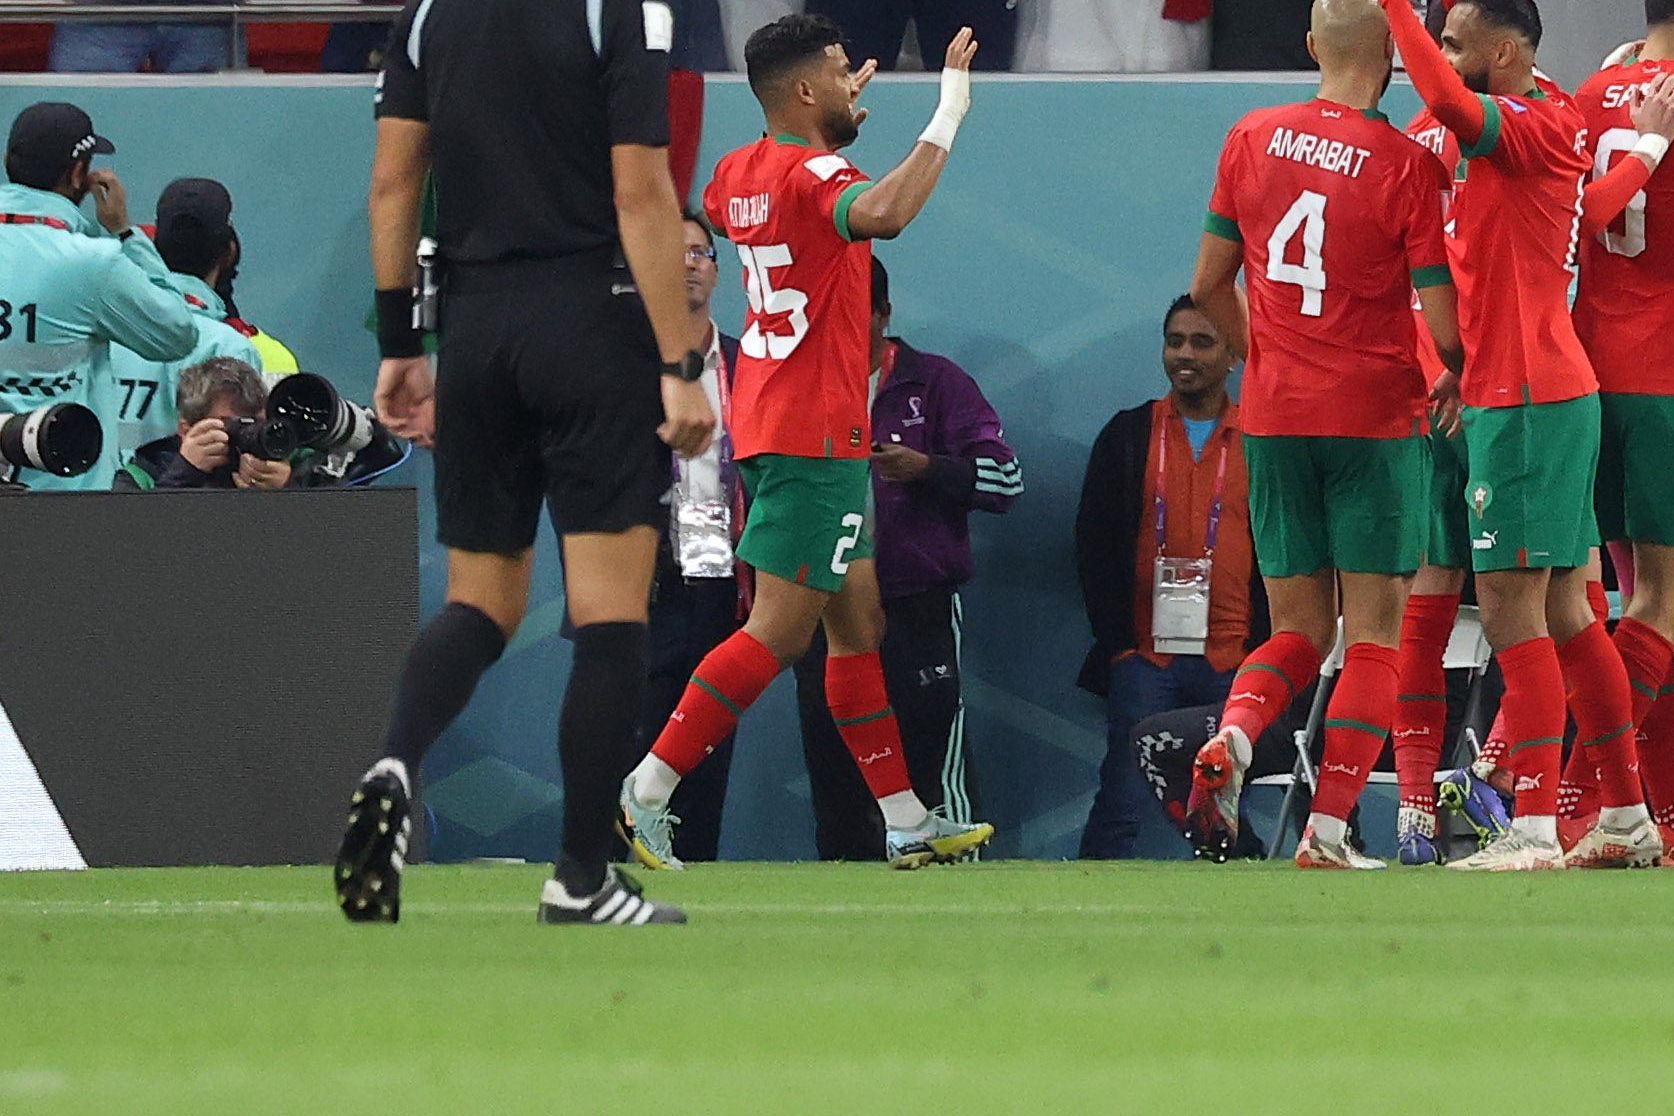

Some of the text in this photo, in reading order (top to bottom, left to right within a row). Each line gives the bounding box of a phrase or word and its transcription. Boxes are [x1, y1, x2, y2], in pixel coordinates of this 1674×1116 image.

[1266, 126, 1372, 179] AMRABAT
[1265, 188, 1328, 318] 4
[118, 378, 159, 421] 77
